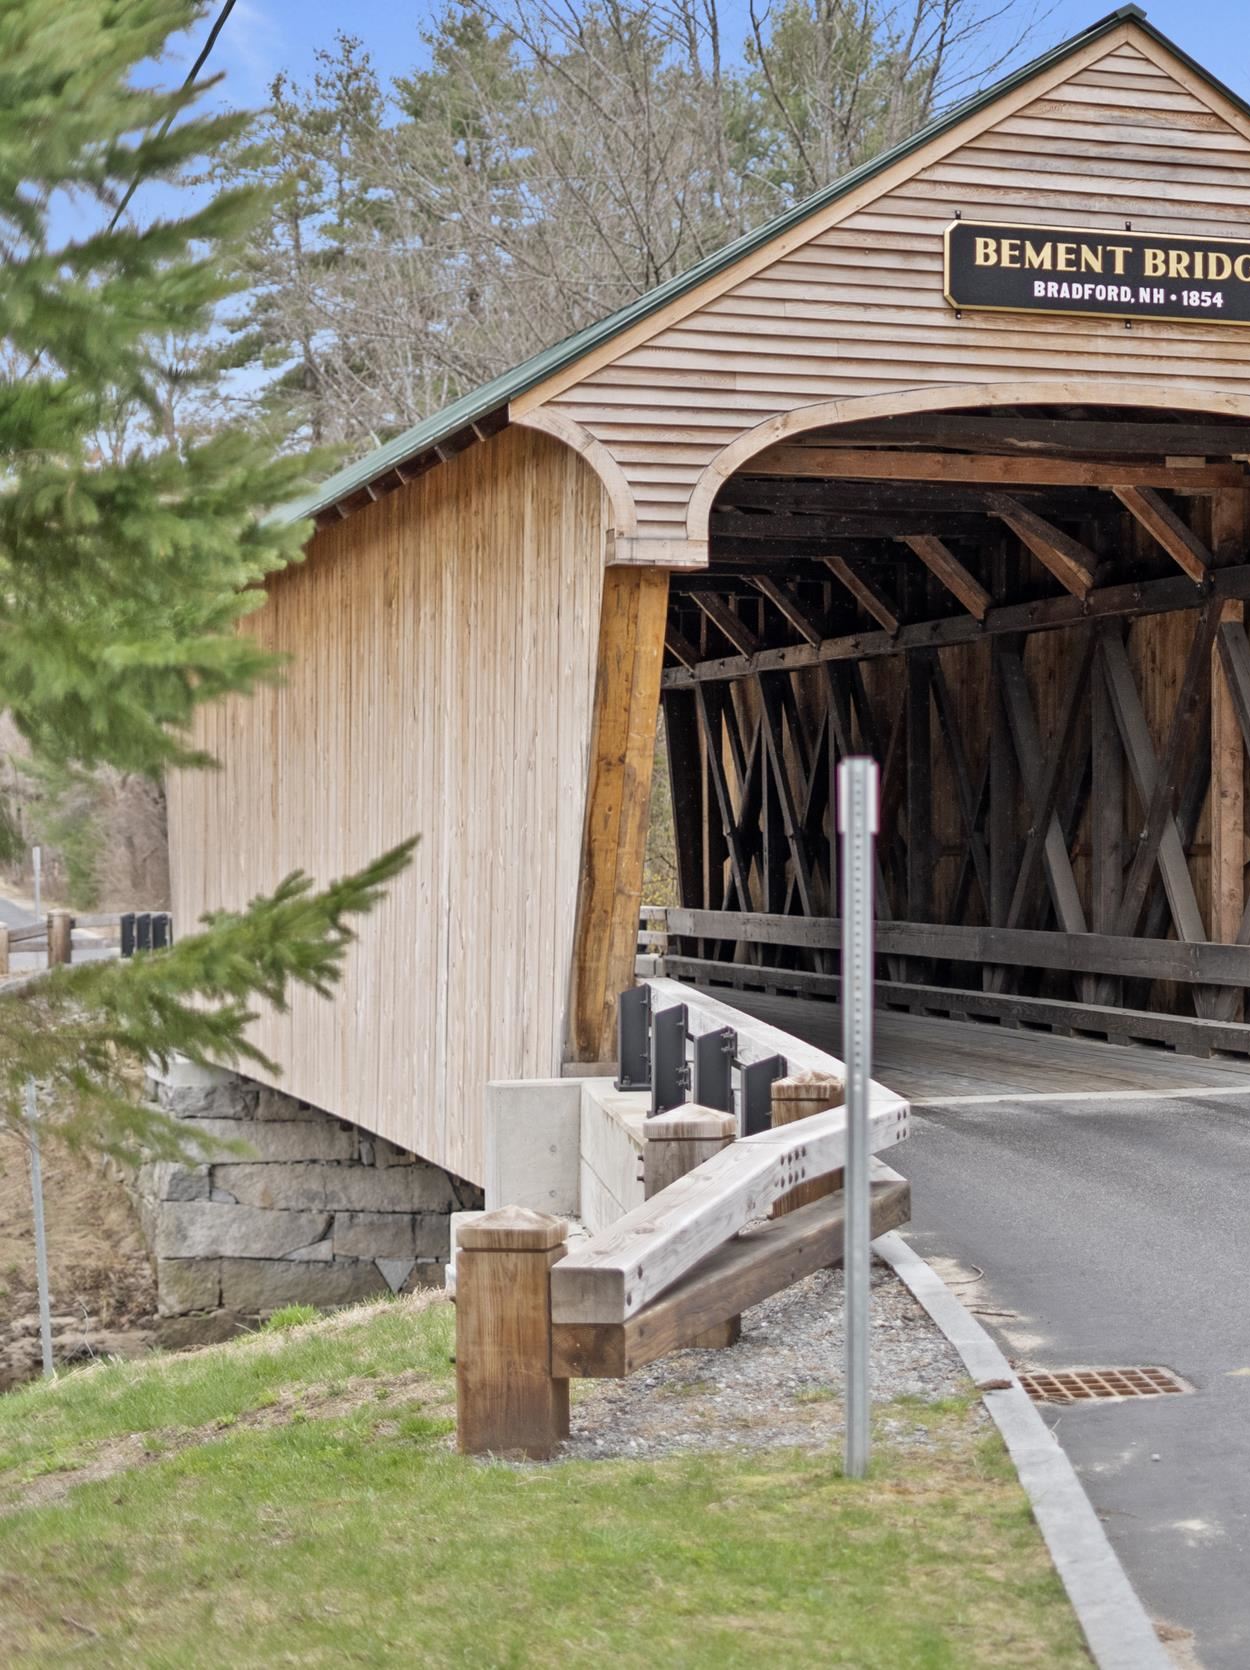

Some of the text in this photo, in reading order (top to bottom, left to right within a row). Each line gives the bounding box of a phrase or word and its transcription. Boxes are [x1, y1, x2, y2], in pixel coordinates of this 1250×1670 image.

[974, 237, 1133, 275] BEMENT
[1033, 280, 1224, 309] BRADFORD, NH 1854
